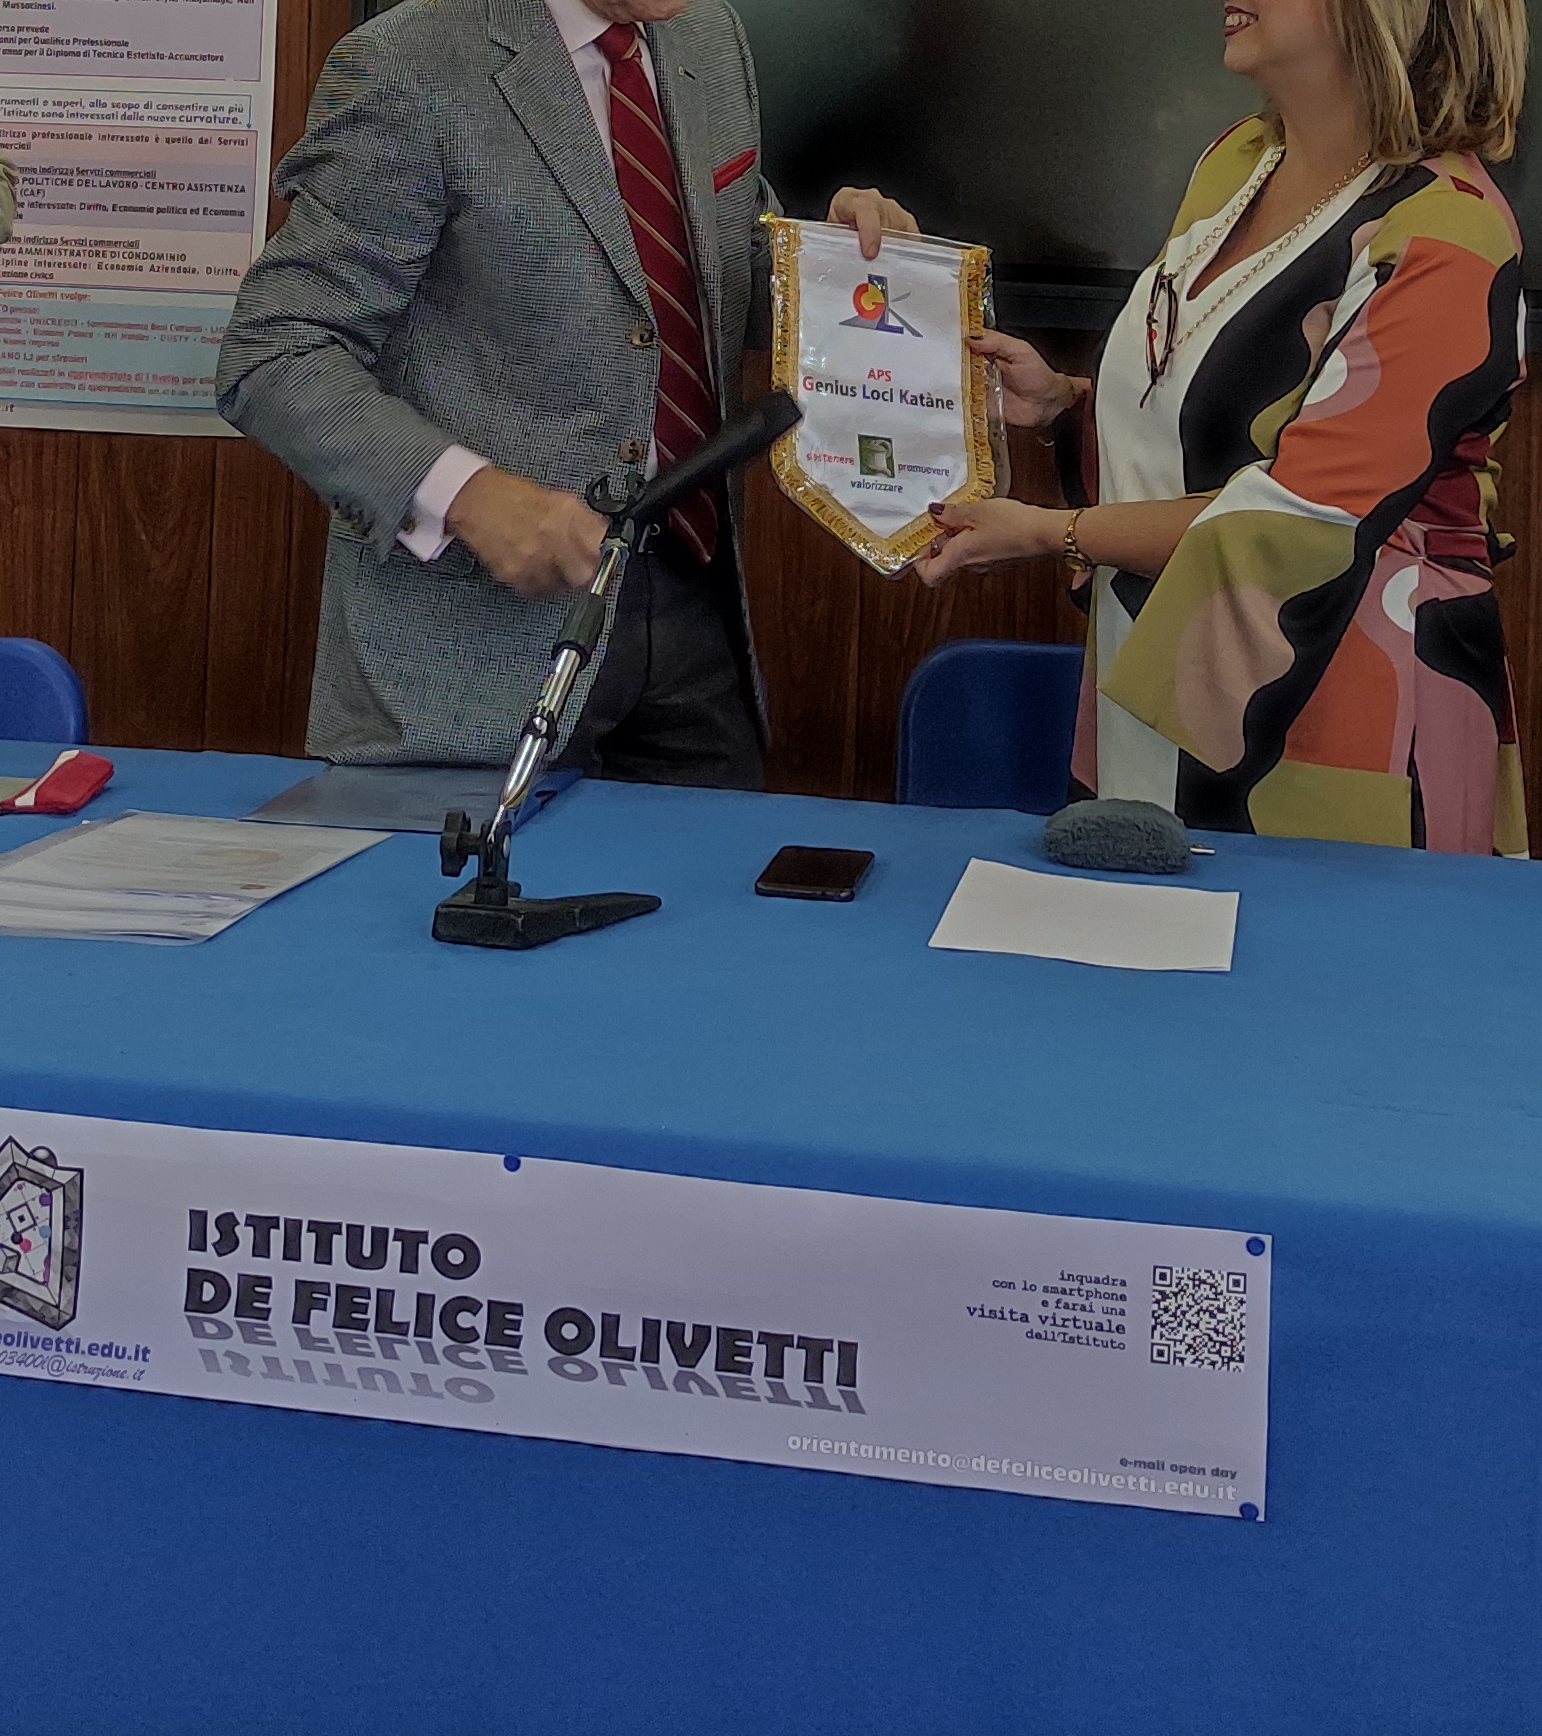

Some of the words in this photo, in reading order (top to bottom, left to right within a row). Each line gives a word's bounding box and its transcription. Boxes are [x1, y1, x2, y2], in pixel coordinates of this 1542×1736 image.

[77, 179, 97, 189] DEL
[867, 368, 892, 382] APS
[802, 376, 857, 398] Genius
[862, 384, 894, 403] Loci
[899, 391, 955, 411] Katàne
[850, 478, 904, 493] valorizzare
[187, 1208, 482, 1280] ISTITUTO
[992, 1278, 1016, 1290] con
[1022, 1280, 1037, 1292] lo
[1042, 1283, 1127, 1302] smartphone
[1059, 1270, 1127, 1288] inquadra
[1054, 1298, 1095, 1313] farai
[1101, 1305, 1126, 1316] una
[183, 1267, 273, 1322] DE
[291, 1279, 524, 1348] FELICE
[544, 1306, 859, 1388] OLIVETTI
[967, 1304, 1030, 1324] visita
[1038, 1313, 1126, 1335] virtuale
[1025, 1328, 1126, 1350] dell'Istituto
[787, 1433, 1238, 1502] orientamento@defeliceolivetti.edu.it
[1119, 1455, 1165, 1472] e-mail
[1170, 1461, 1206, 1478] open
[1210, 1465, 1237, 1480] day
